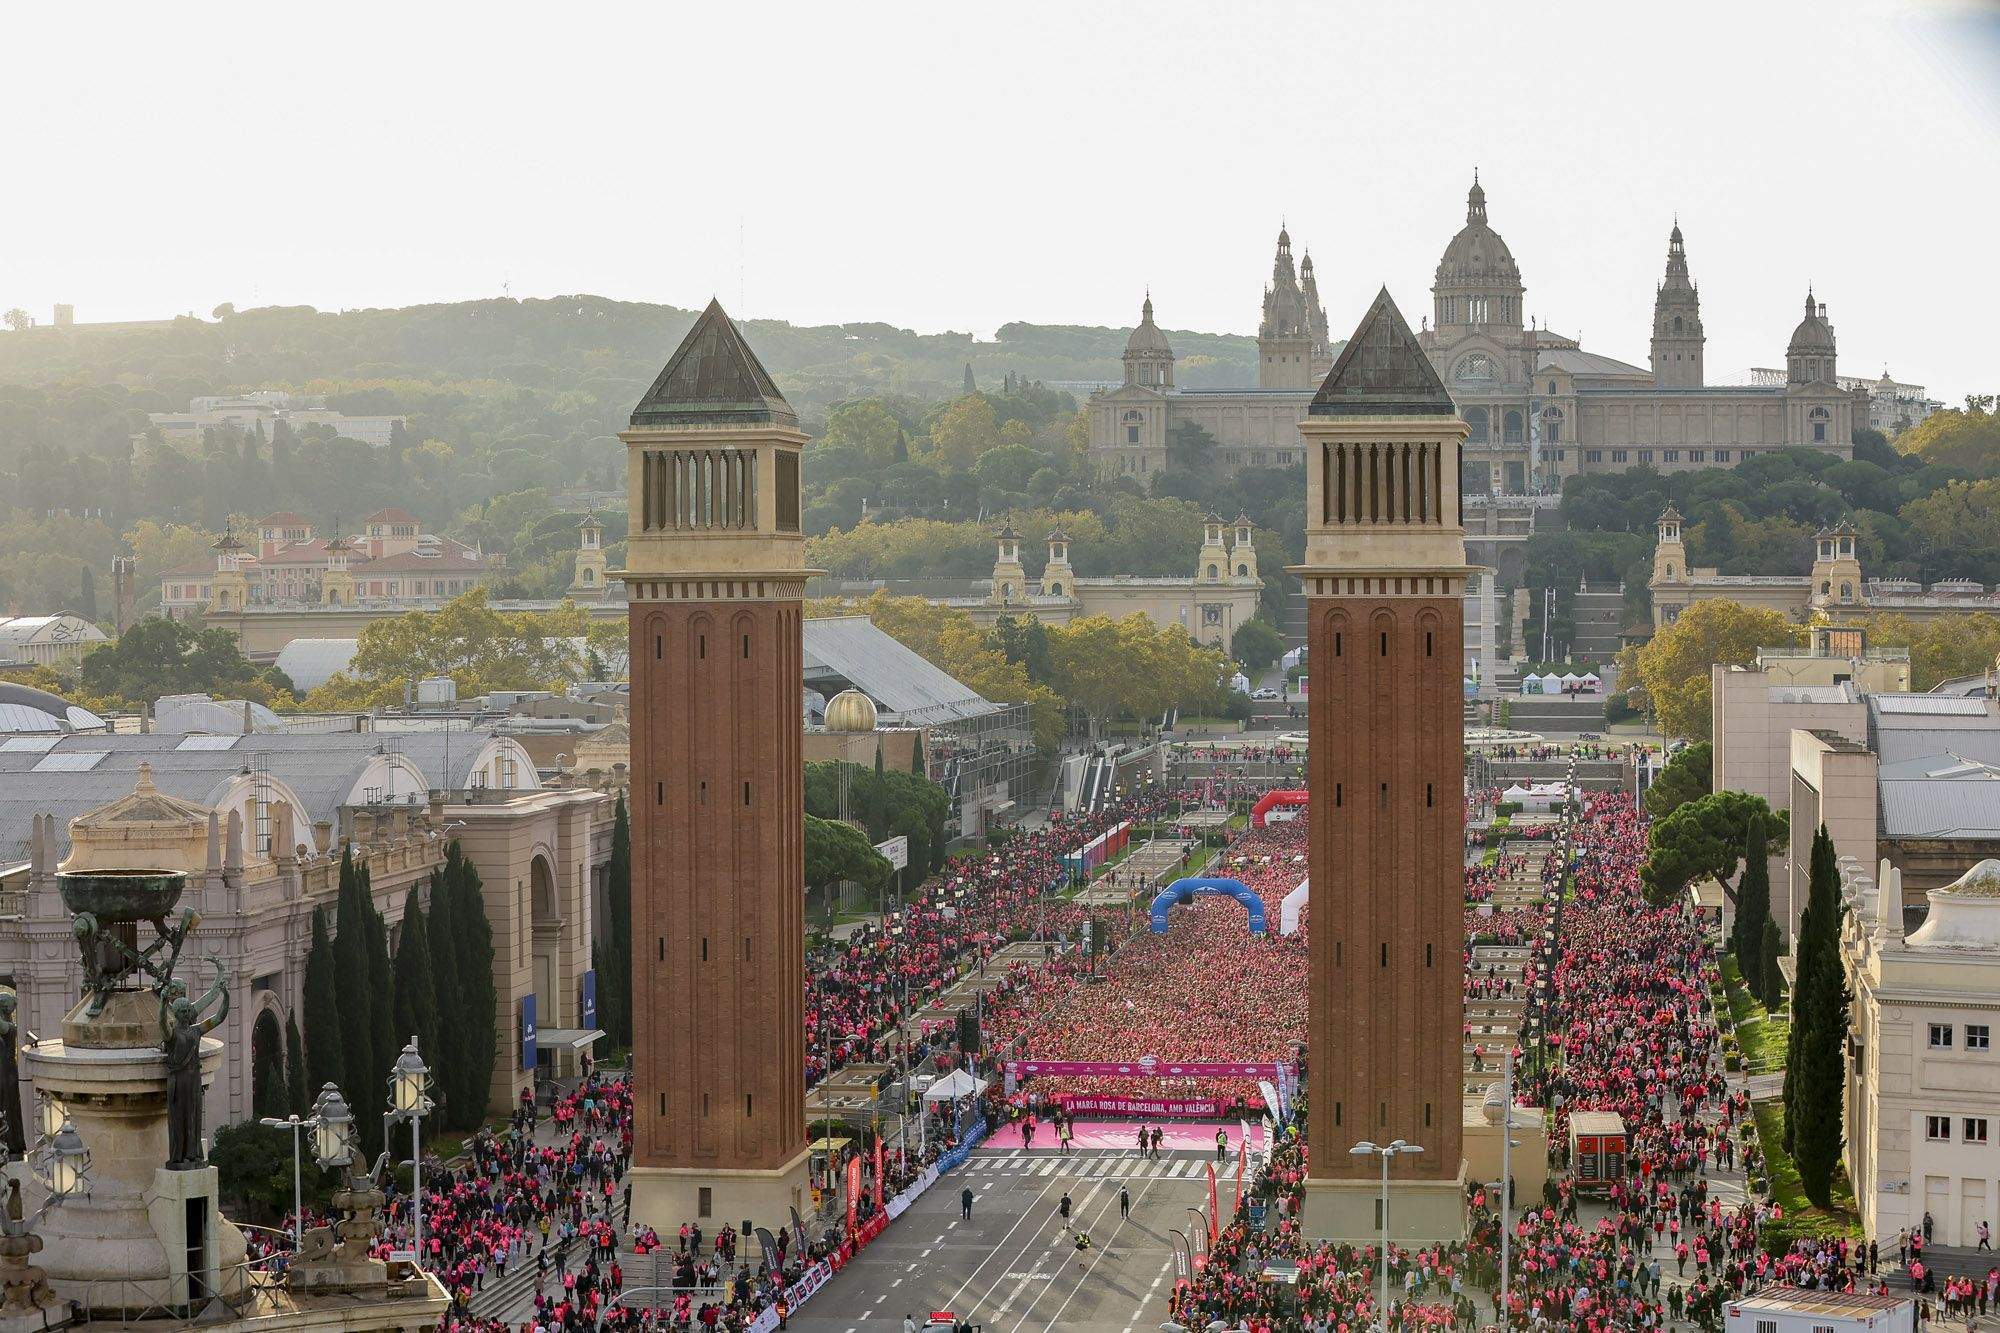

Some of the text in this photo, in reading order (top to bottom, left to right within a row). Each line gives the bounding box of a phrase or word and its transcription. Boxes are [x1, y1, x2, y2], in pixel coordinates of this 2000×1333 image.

[1066, 1100, 1215, 1114] LA MAREA ROSA DE BARCELONA, AMB VALÈNCIA
